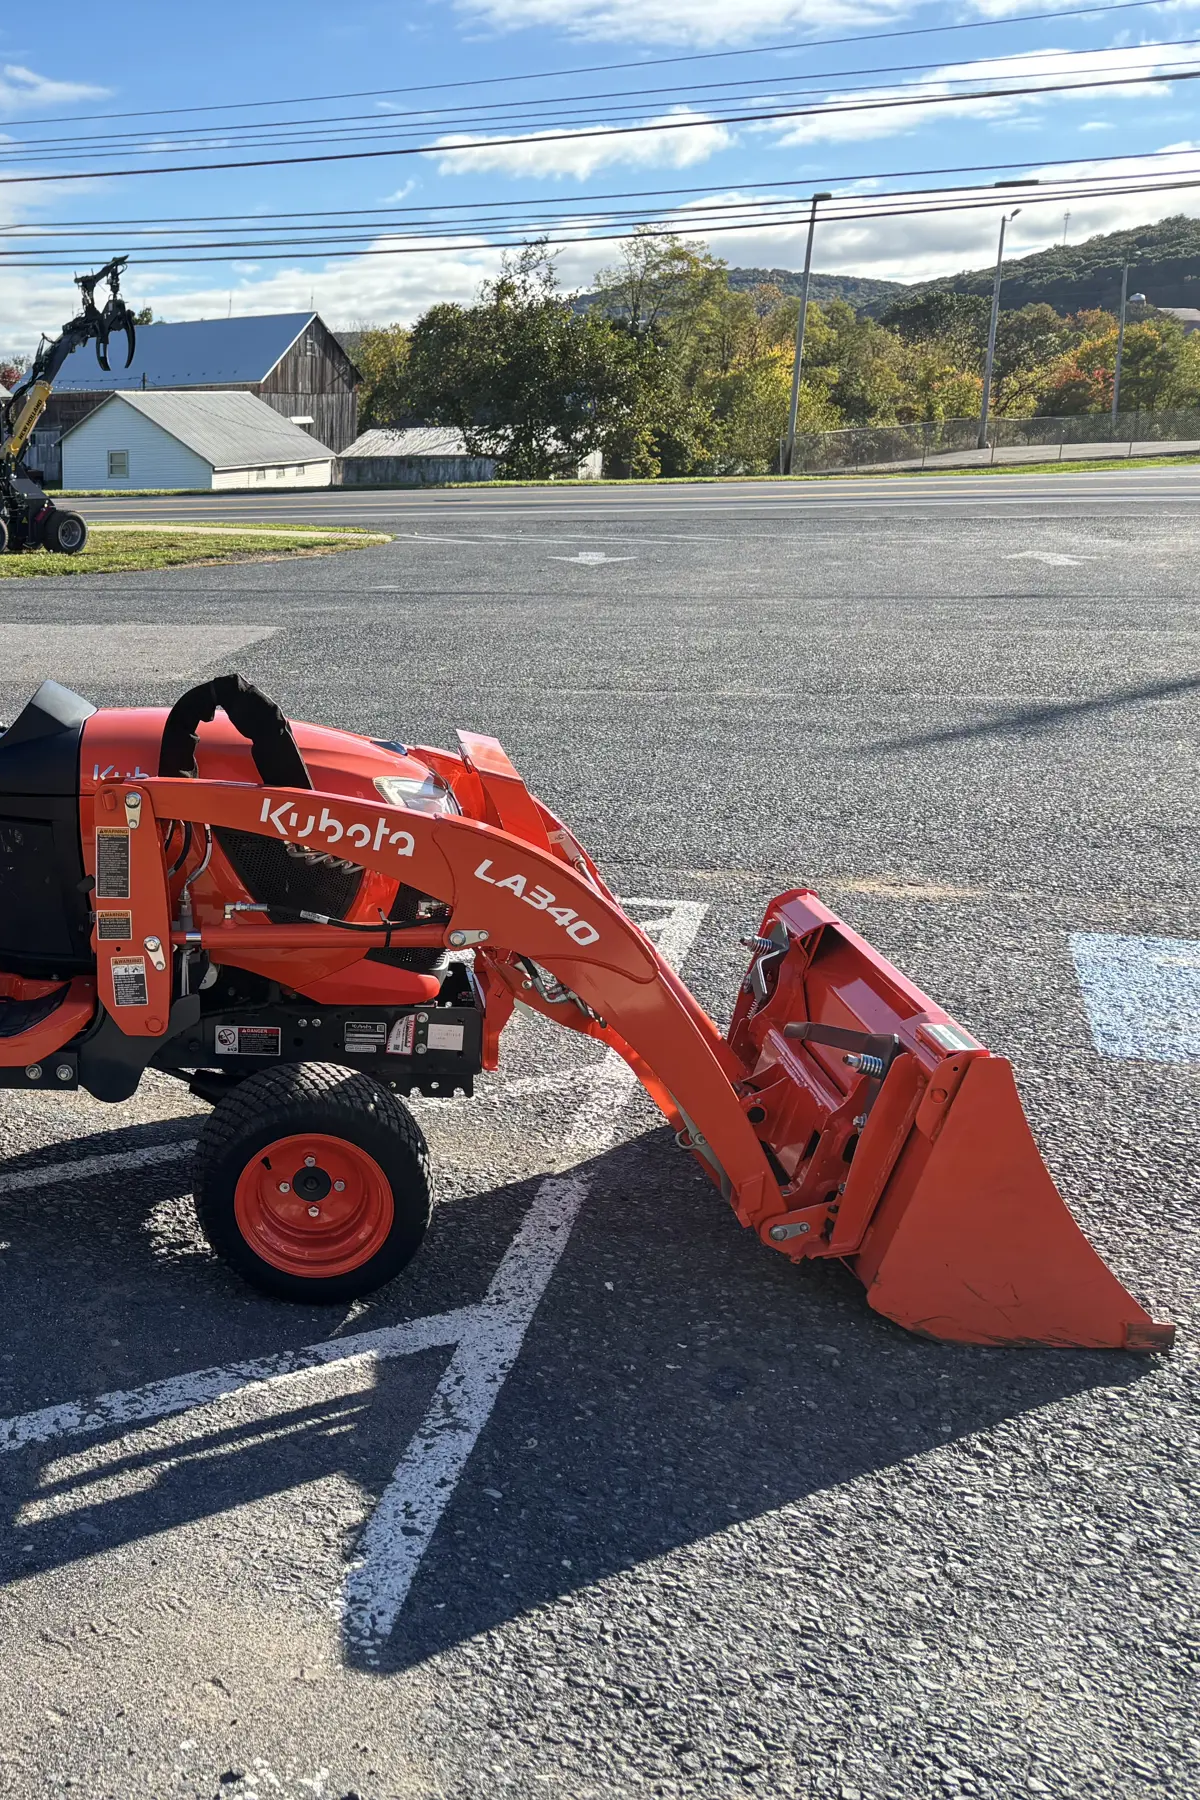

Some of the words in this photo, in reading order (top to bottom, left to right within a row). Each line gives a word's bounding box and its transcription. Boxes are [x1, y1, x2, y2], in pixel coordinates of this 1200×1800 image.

[18, 425, 29, 440] NEW
[26, 399, 43, 426] HOLLAND
[259, 797, 415, 857] Kubota
[473, 858, 600, 946] LA340
